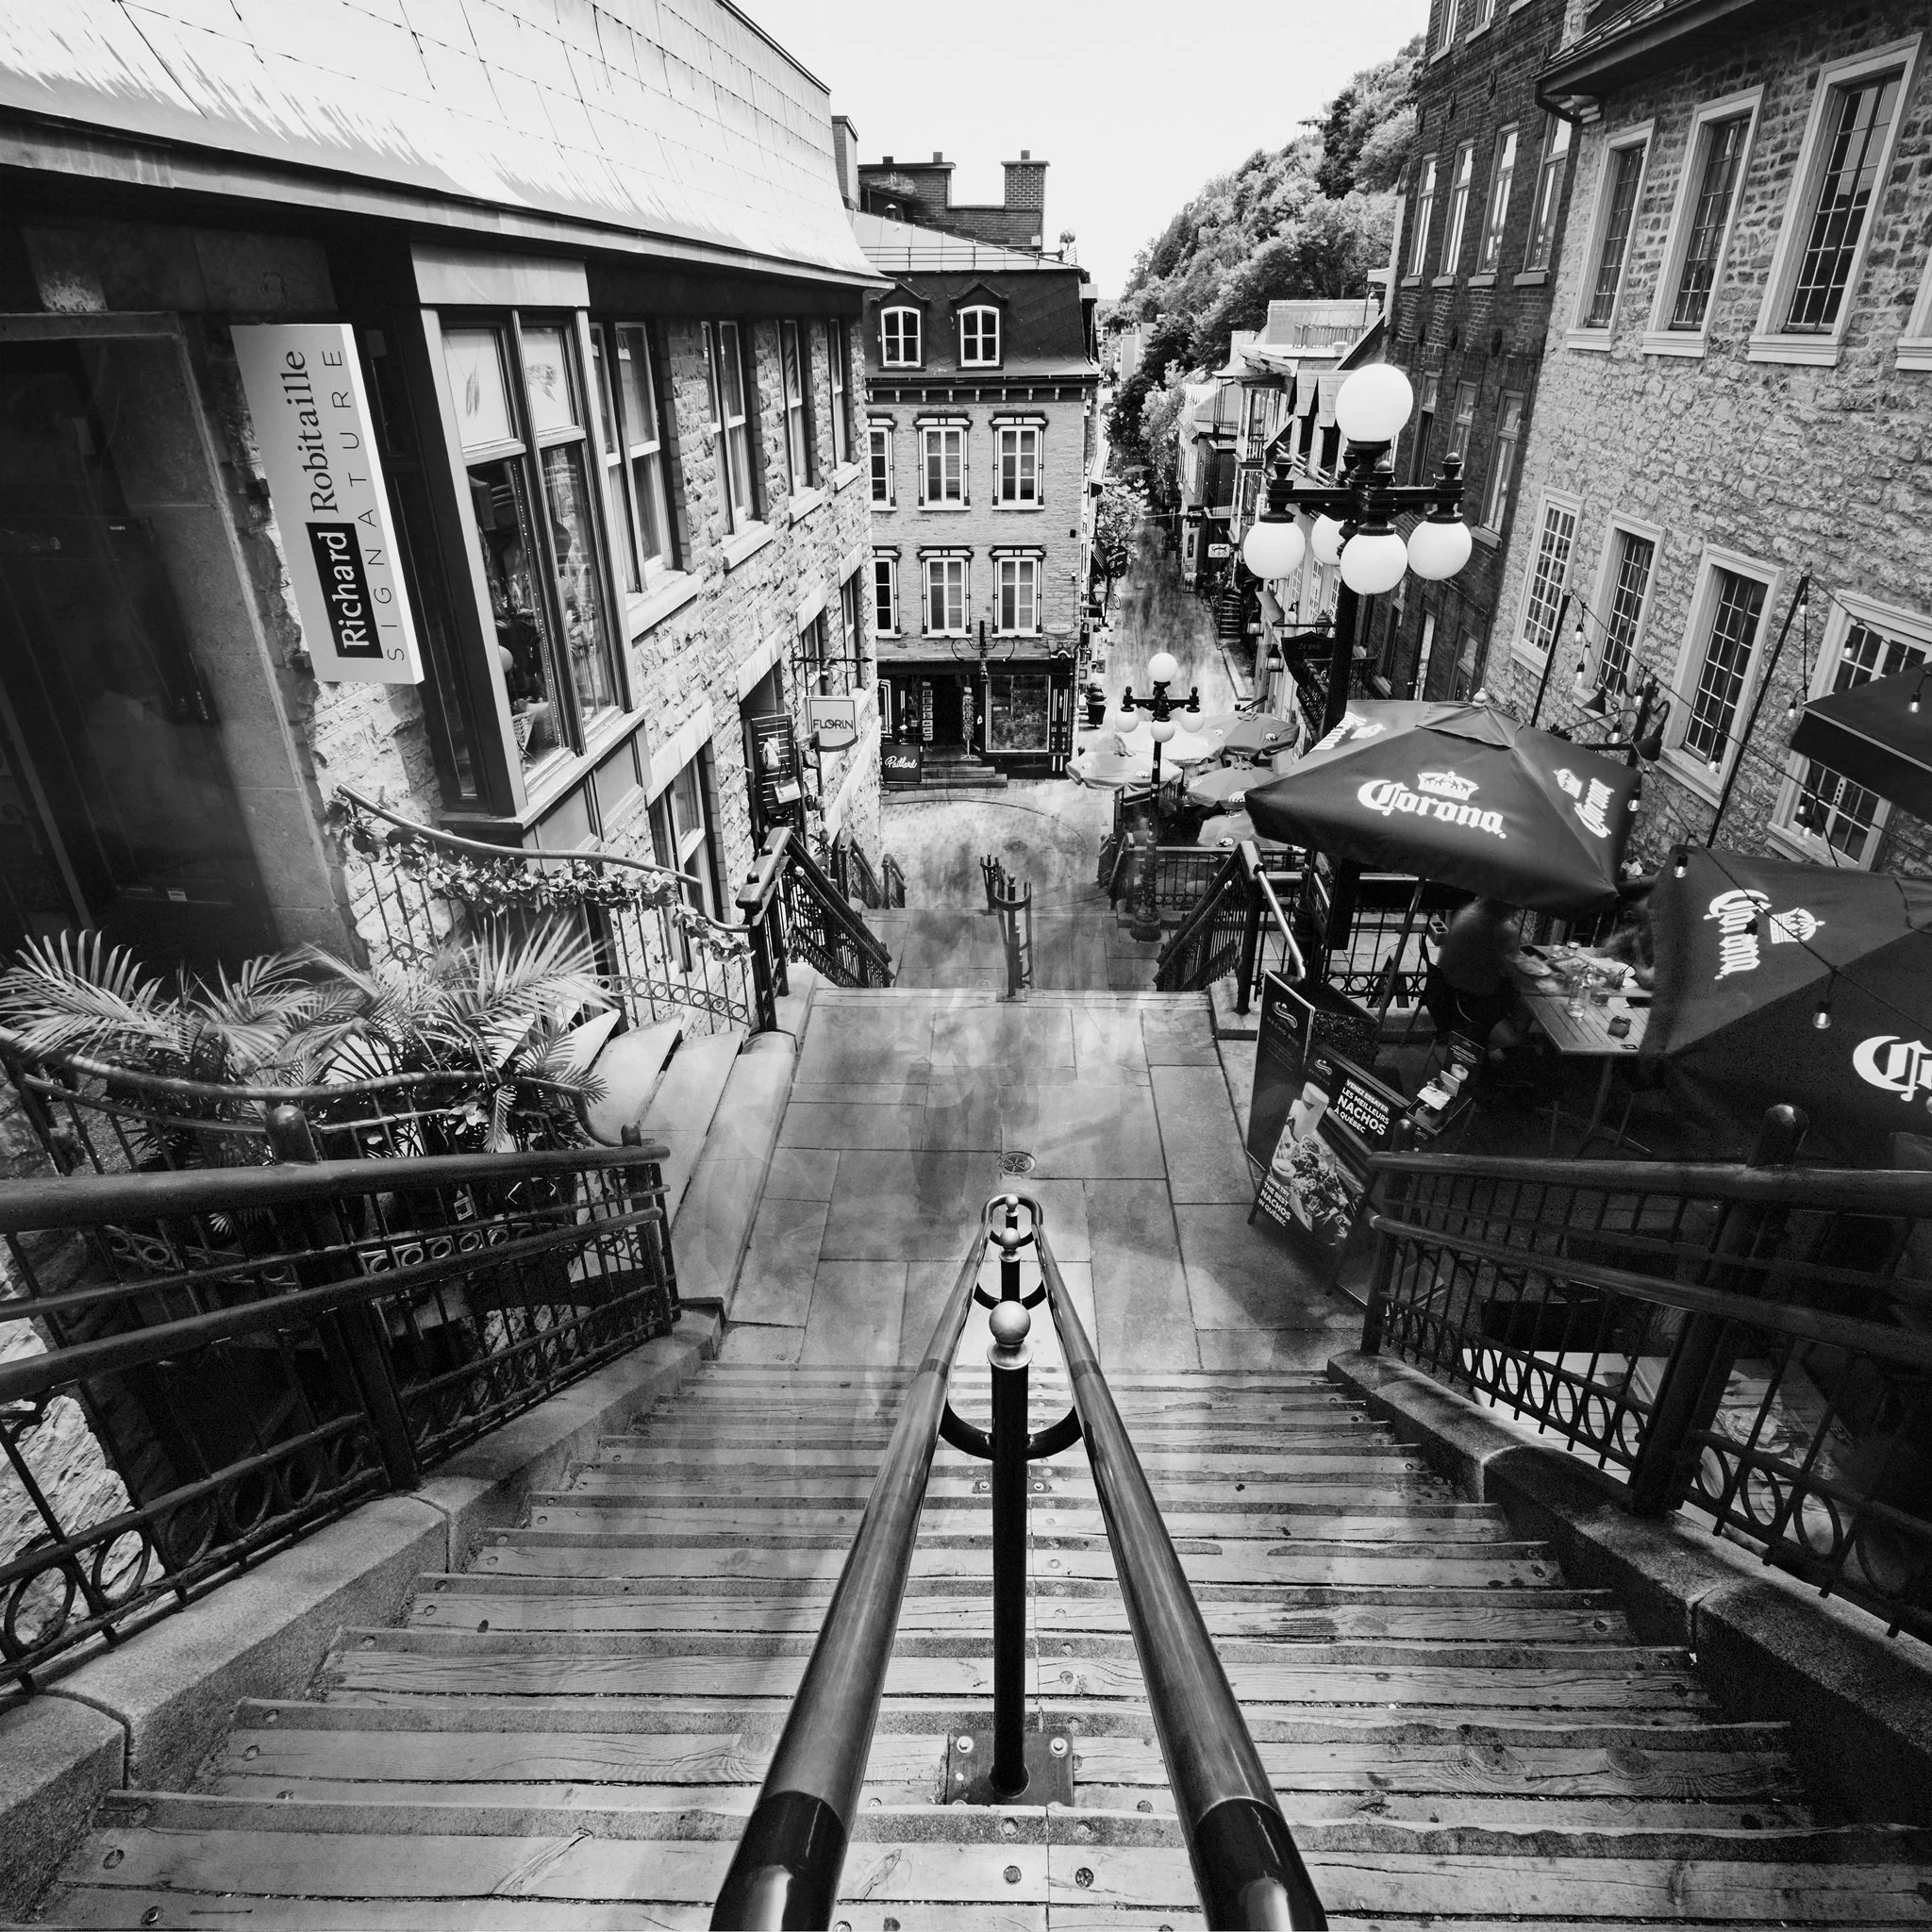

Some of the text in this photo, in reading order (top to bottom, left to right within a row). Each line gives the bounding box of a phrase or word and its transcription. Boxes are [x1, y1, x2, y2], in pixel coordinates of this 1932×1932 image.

[280, 350, 370, 649] Richard Robitaille
[322, 350, 405, 660] SIGNATURE
[813, 719, 854, 729] FLORIN
[884, 755, 918, 769] Paillard
[1357, 779, 1507, 839] Corona
[1574, 777, 1615, 838] Corona
[1704, 889, 1773, 980] Corona
[1341, 1087, 1390, 1124] LES MEILLEURS
[1345, 1079, 1390, 1113] VENEZ ESSAYER
[1338, 1094, 1386, 1135] NACHOS
[1340, 1111, 1366, 1134] QUÉBEC
[1264, 1181, 1289, 1207] THE BEST
[1267, 1175, 1291, 1198] COME TRY
[1257, 1198, 1287, 1227] IN QUÉBEC
[1260, 1189, 1291, 1220] NACHOS
